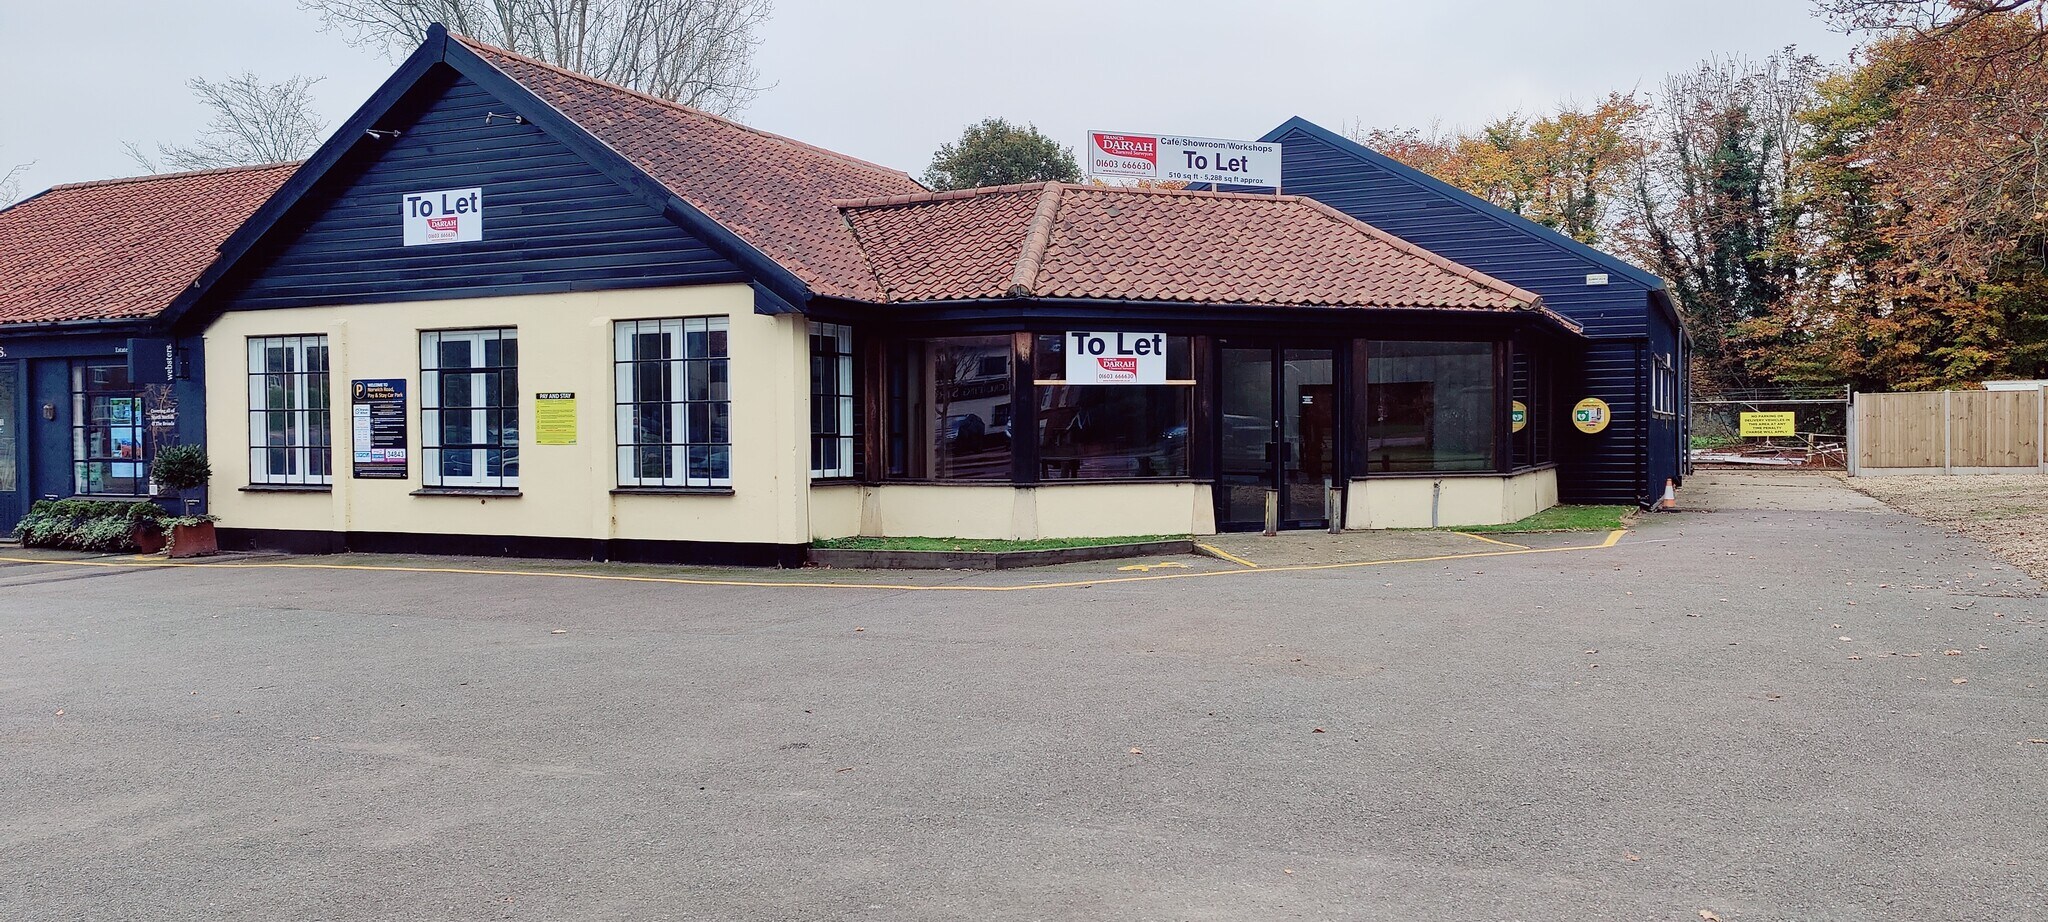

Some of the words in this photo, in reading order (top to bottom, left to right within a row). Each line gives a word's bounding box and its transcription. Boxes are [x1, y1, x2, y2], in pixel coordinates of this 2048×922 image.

[1103, 139, 1154, 152] DARRAH
[1160, 137, 1273, 154] Café/Showroom/Workshops
[1096, 159, 1118, 168] 01603
[1122, 161, 1152, 171] 666630
[1183, 150, 1208, 170] To
[1215, 152, 1248, 173] Let
[1240, 177, 1264, 185] approx
[407, 196, 433, 218] To
[441, 192, 478, 215] Let
[1071, 332, 1105, 356] To
[1117, 332, 1162, 356] Let
